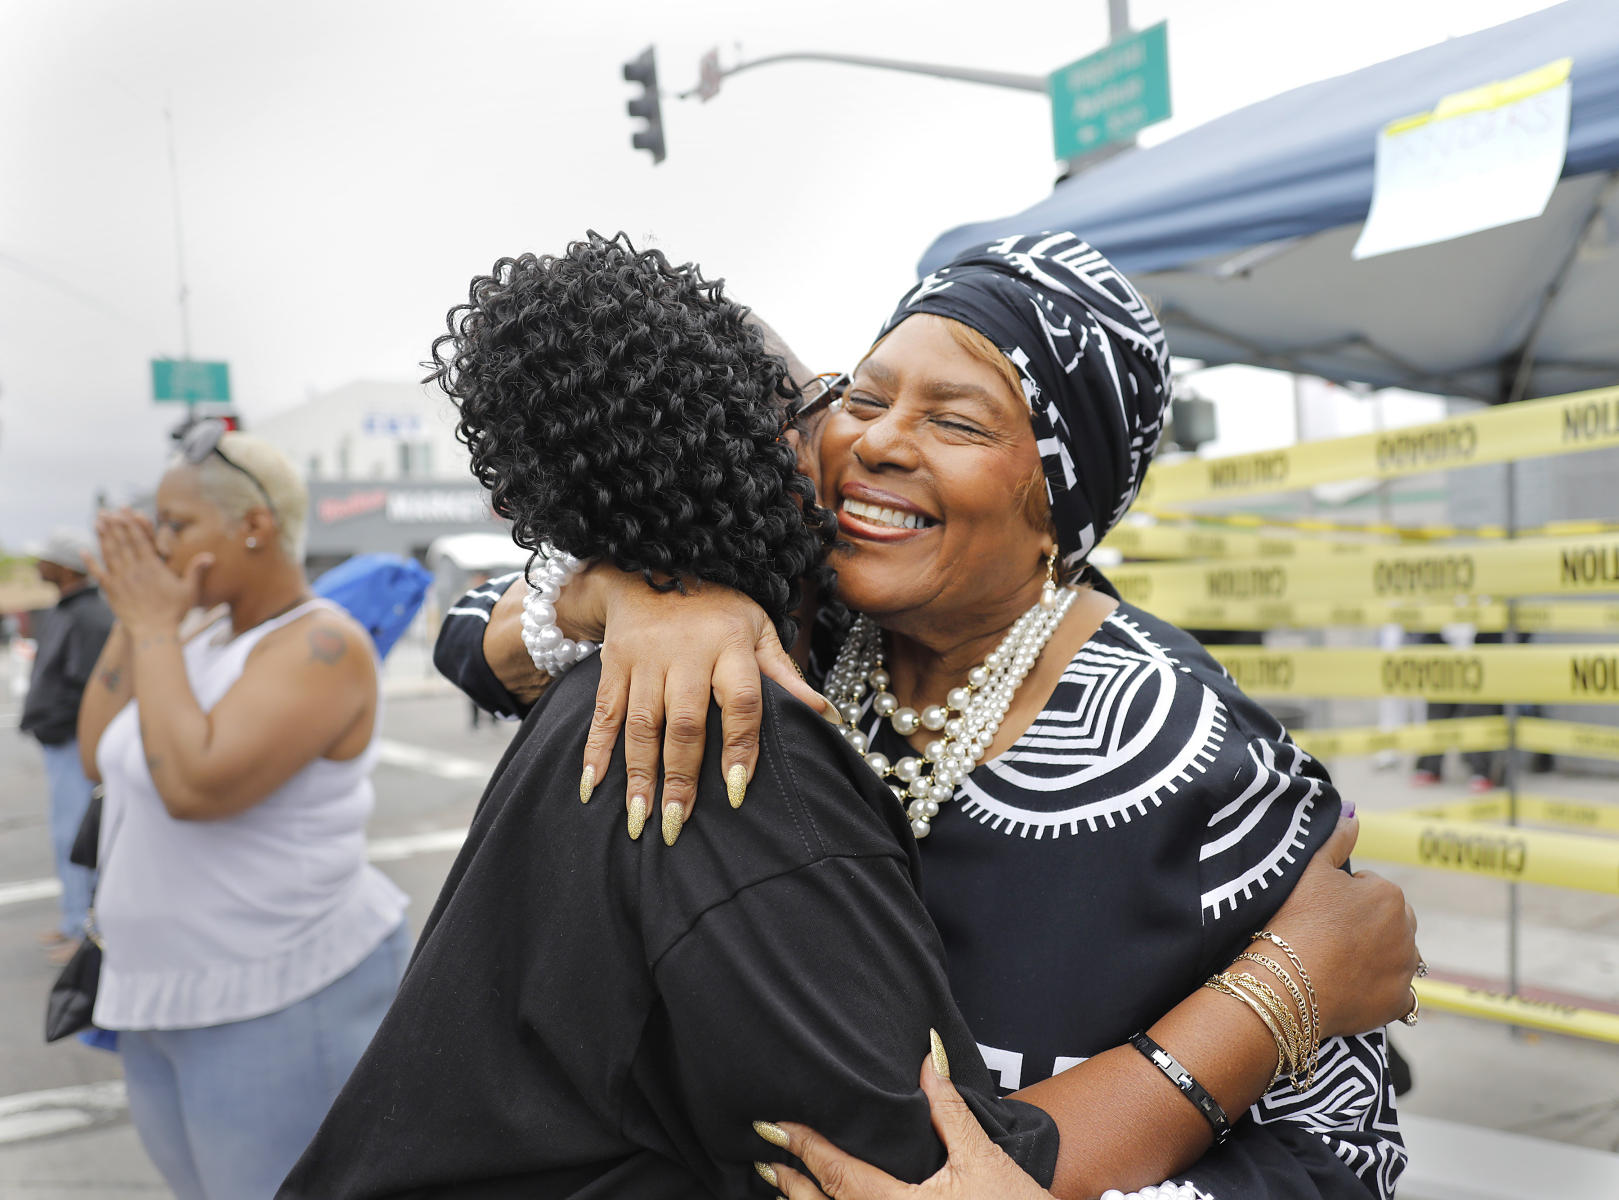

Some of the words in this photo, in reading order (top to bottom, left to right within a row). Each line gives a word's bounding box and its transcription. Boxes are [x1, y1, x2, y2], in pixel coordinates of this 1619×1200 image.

[1376, 424, 1477, 467] CUIDADO
[1209, 455, 1288, 489] CAUTION
[1206, 566, 1288, 600] CAUTION
[1373, 554, 1475, 596] CUIDADO
[1382, 656, 1484, 695] CUIDADO
[1420, 829, 1525, 875] CUIDADO
